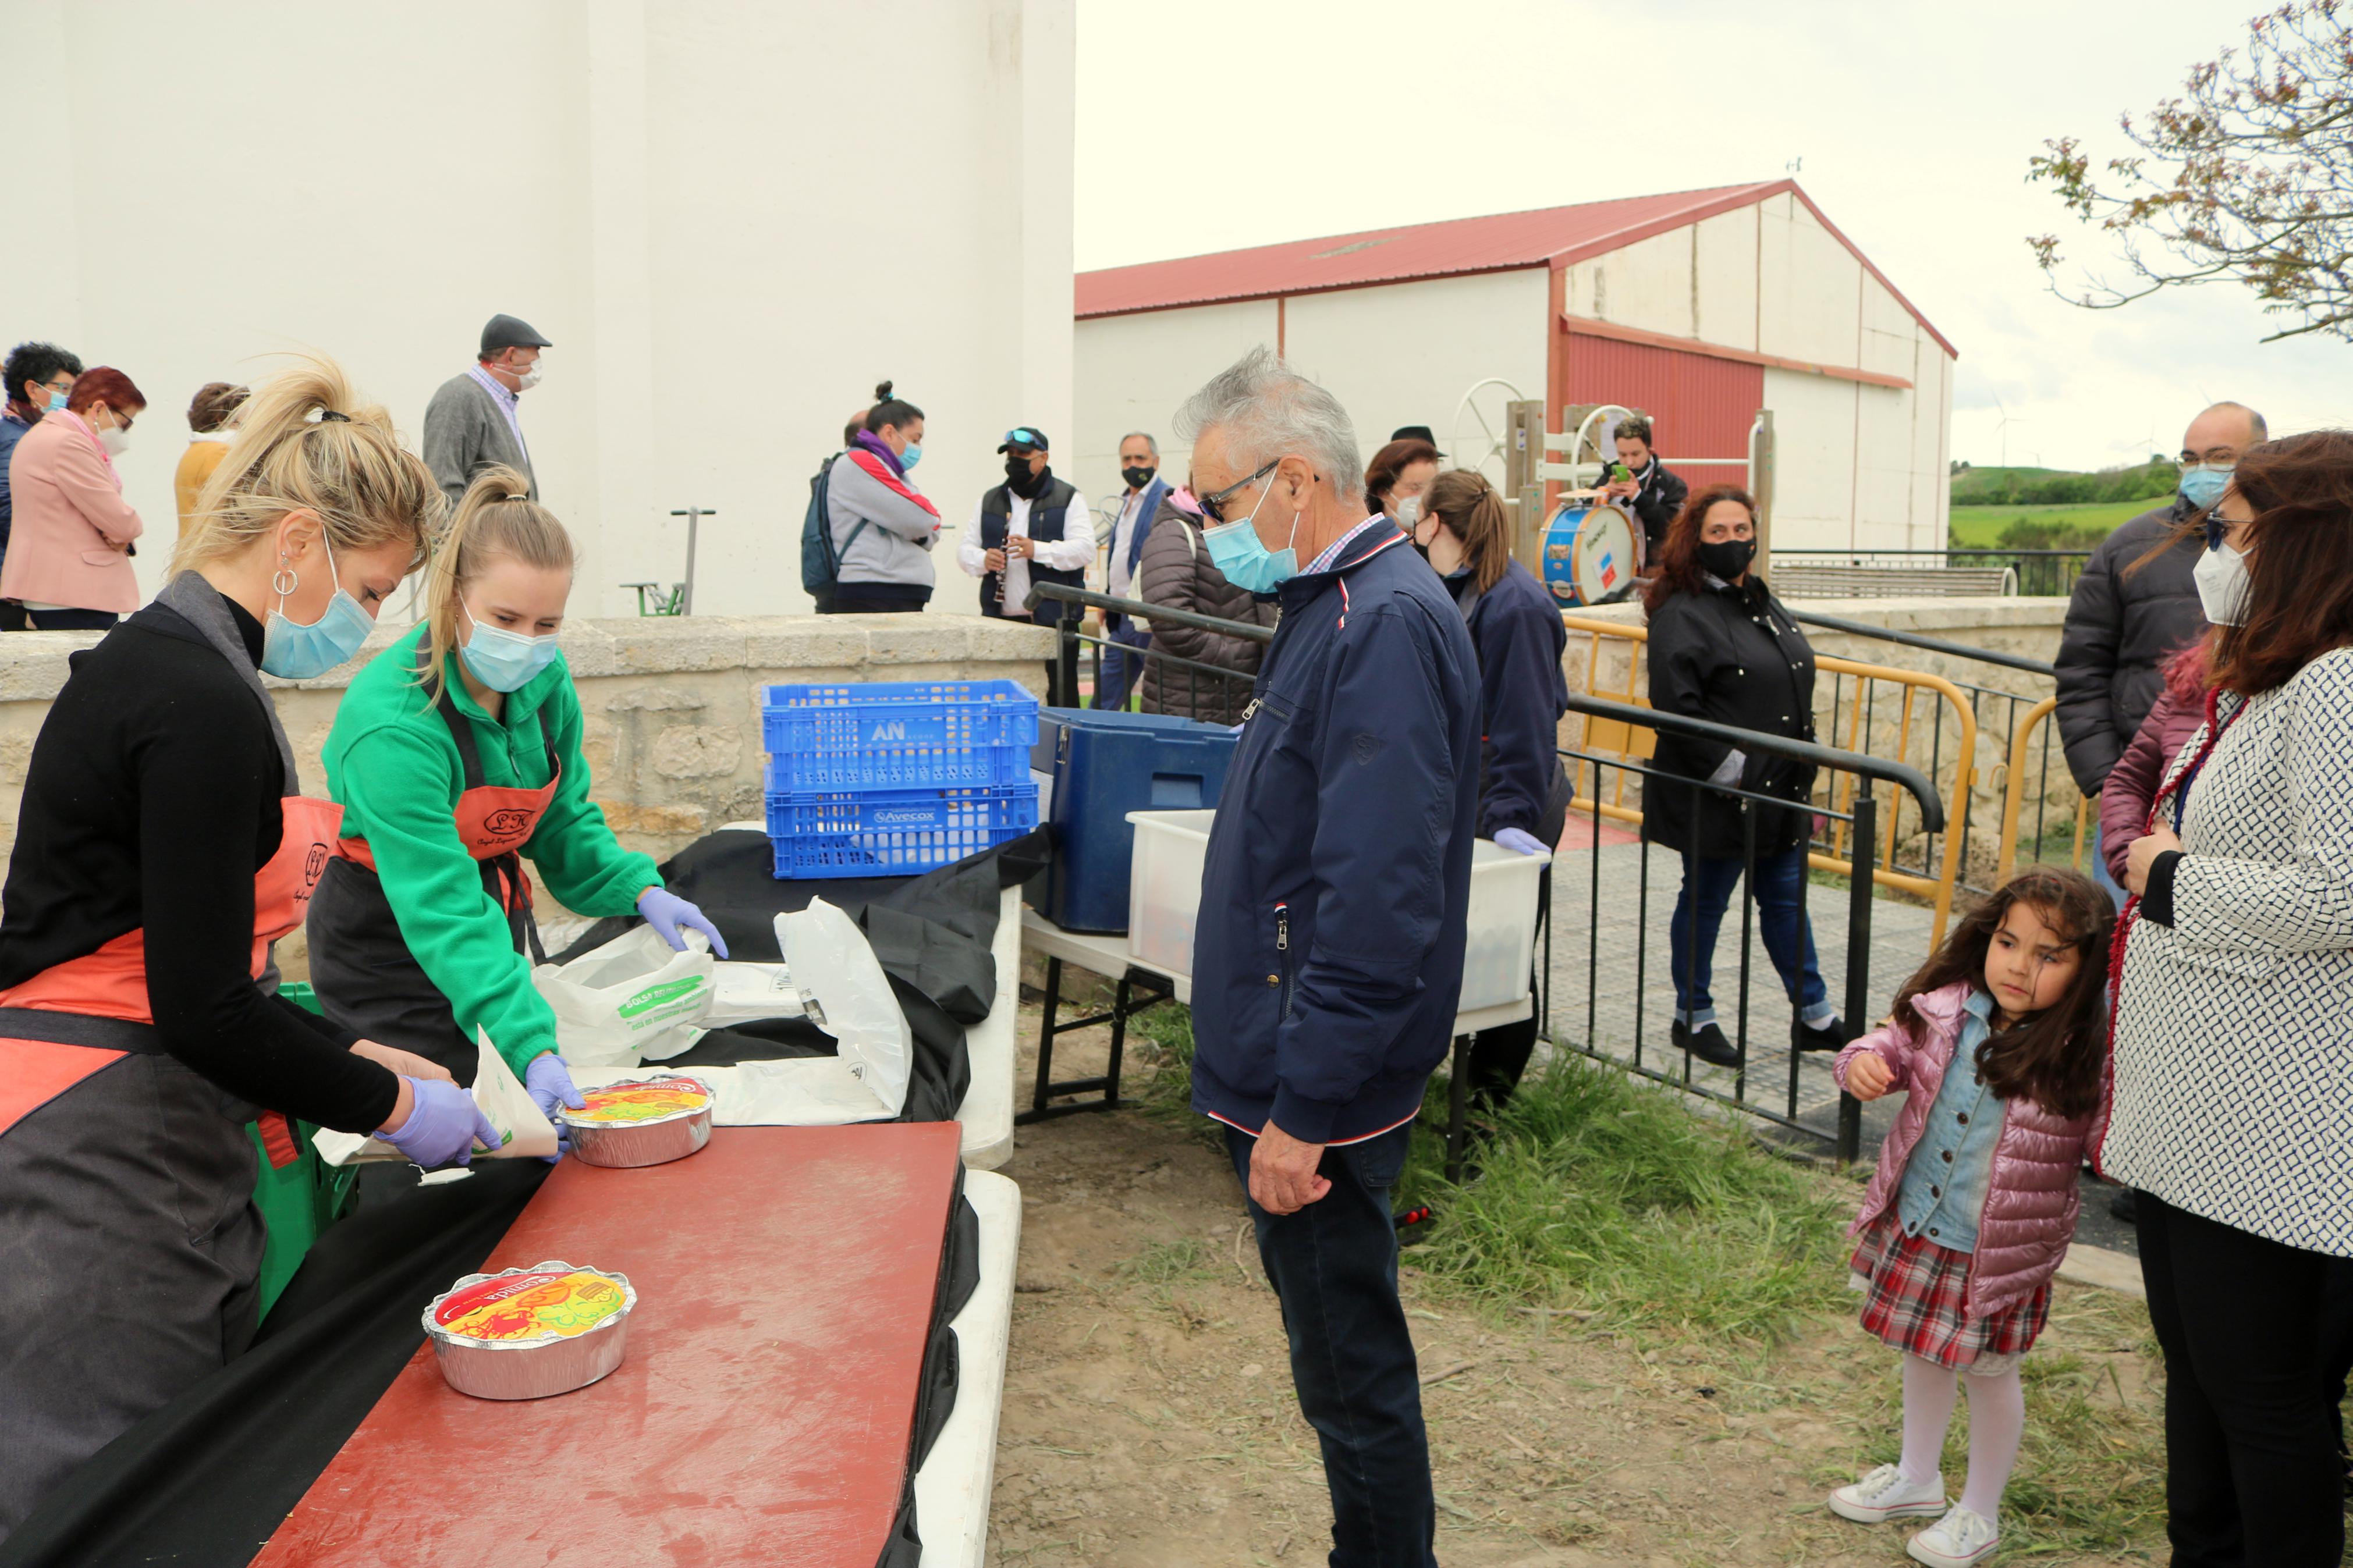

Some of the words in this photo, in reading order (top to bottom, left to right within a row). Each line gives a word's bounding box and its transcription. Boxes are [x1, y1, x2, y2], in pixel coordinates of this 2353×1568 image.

[871, 722, 904, 741] AN
[885, 812, 935, 822] Avecox
[626, 991, 652, 1008] BOLSA
[484, 1275, 556, 1300] Comida
